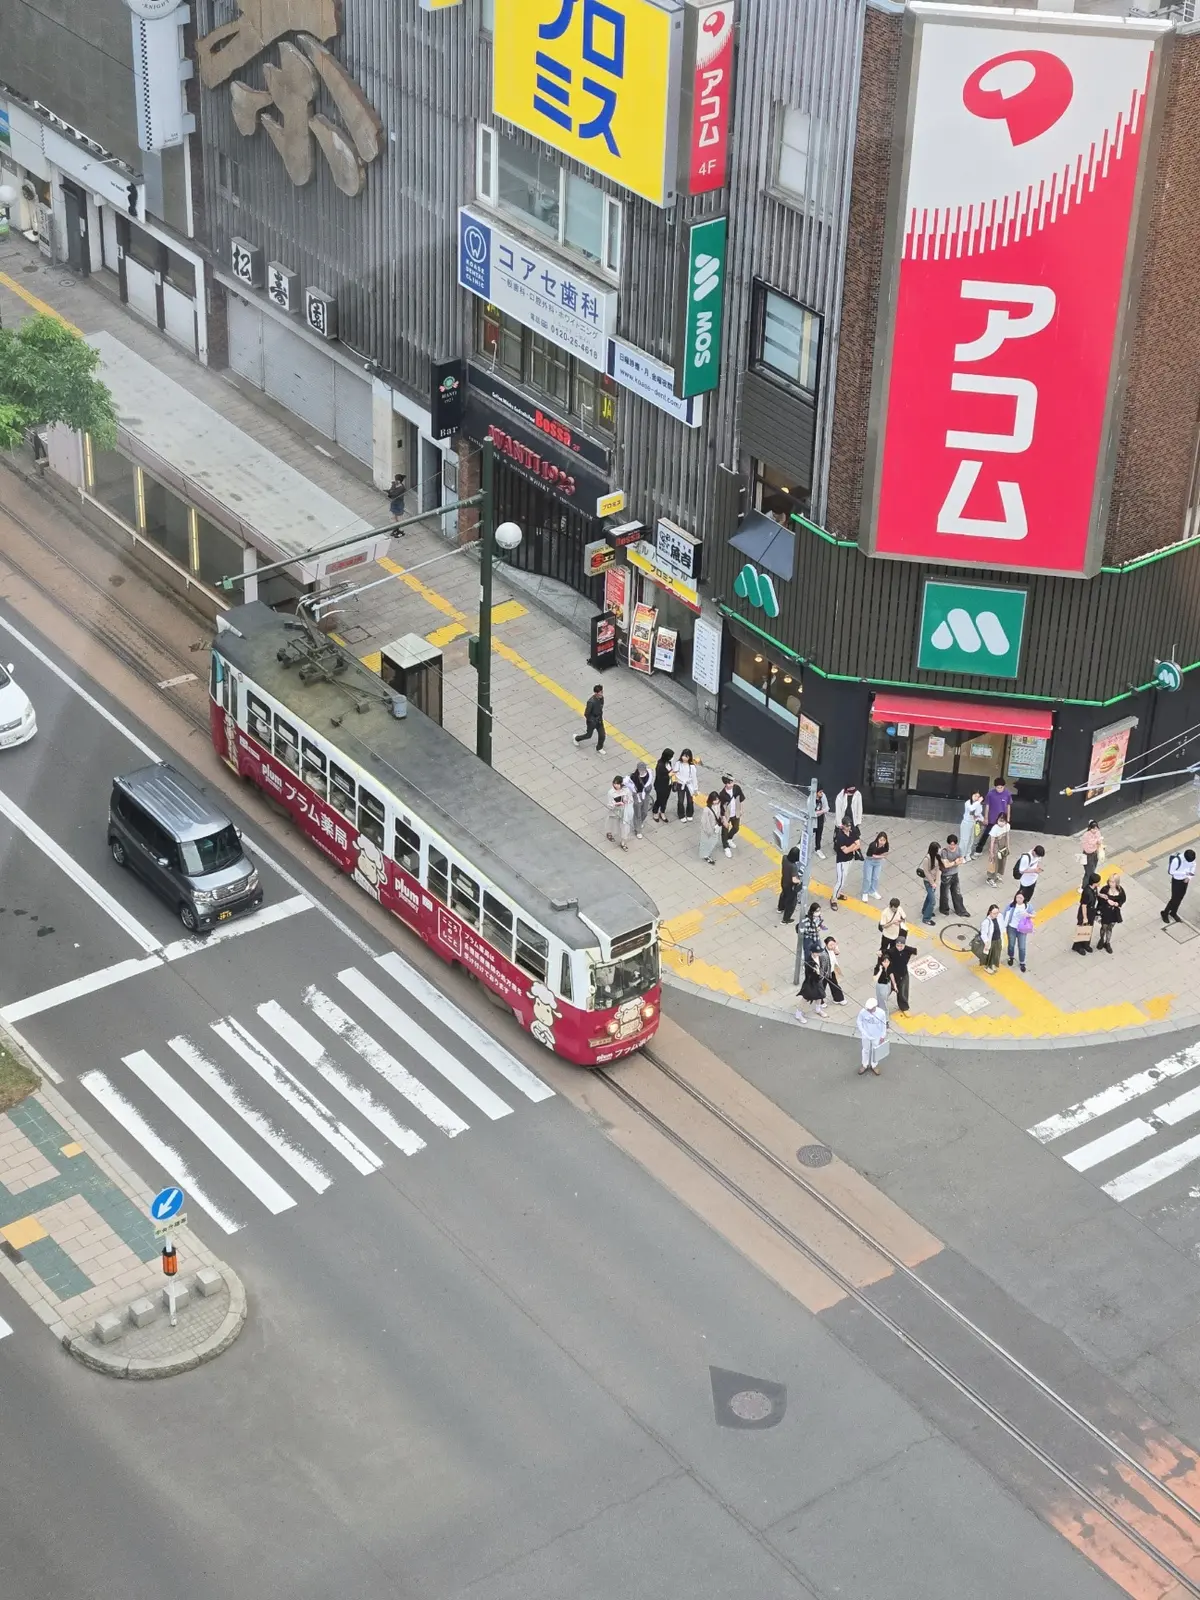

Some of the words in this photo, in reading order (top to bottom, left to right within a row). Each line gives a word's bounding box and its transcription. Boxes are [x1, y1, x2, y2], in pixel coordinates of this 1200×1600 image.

[533, 50, 622, 159] ミス
[698, 68, 723, 149] アコム
[698, 159, 717, 176] 4F
[499, 244, 599, 325] コアセ歯科
[550, 325, 598, 360] 0120-25-4618
[693, 311, 712, 368] MOS
[535, 409, 572, 447] Bossa
[936, 279, 1056, 541] アコム
[440, 426, 459, 438] Bar
[650, 564, 675, 586] プロミス
[262, 763, 282, 788] plum
[284, 781, 347, 851] プラム薬局
[395, 877, 419, 906] plum
[442, 915, 458, 933] こころ
